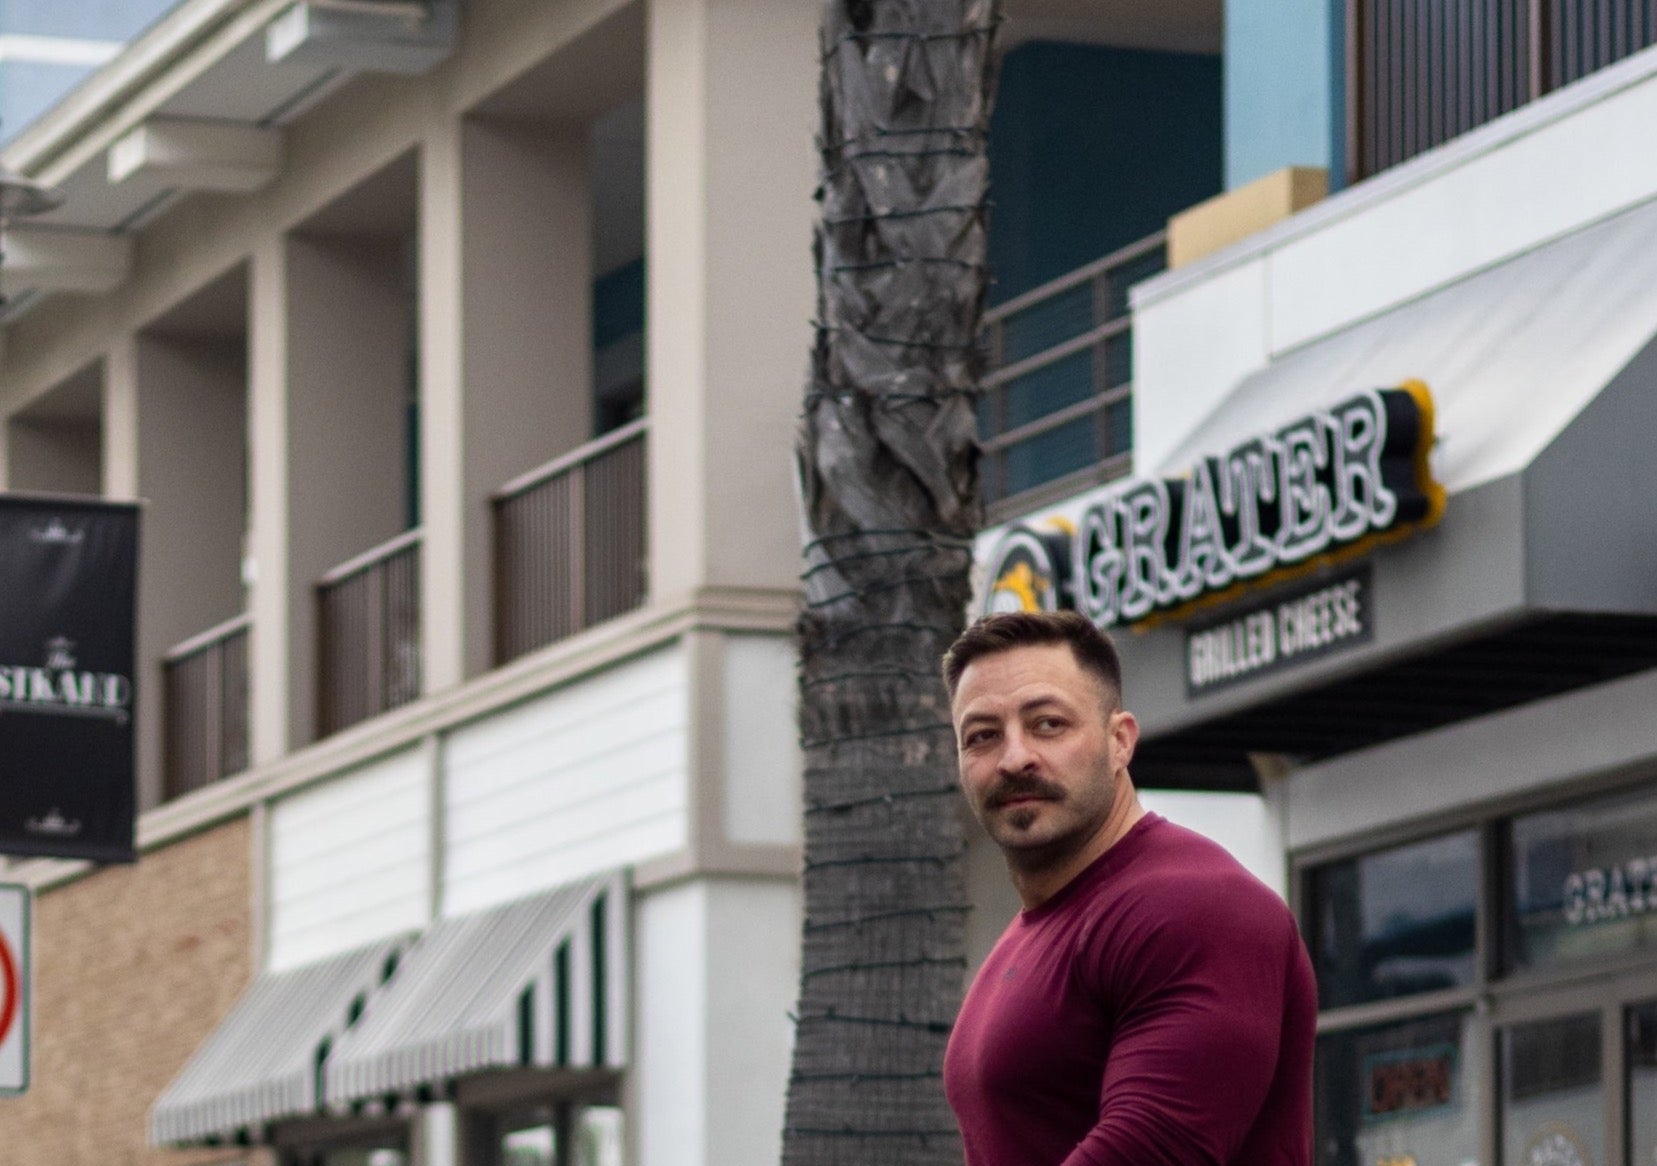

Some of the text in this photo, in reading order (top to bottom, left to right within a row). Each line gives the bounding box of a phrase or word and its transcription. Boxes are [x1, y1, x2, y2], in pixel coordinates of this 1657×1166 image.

[1073, 390, 1396, 629] GRATER
[1190, 580, 1361, 687] GRILLED CHEESE
